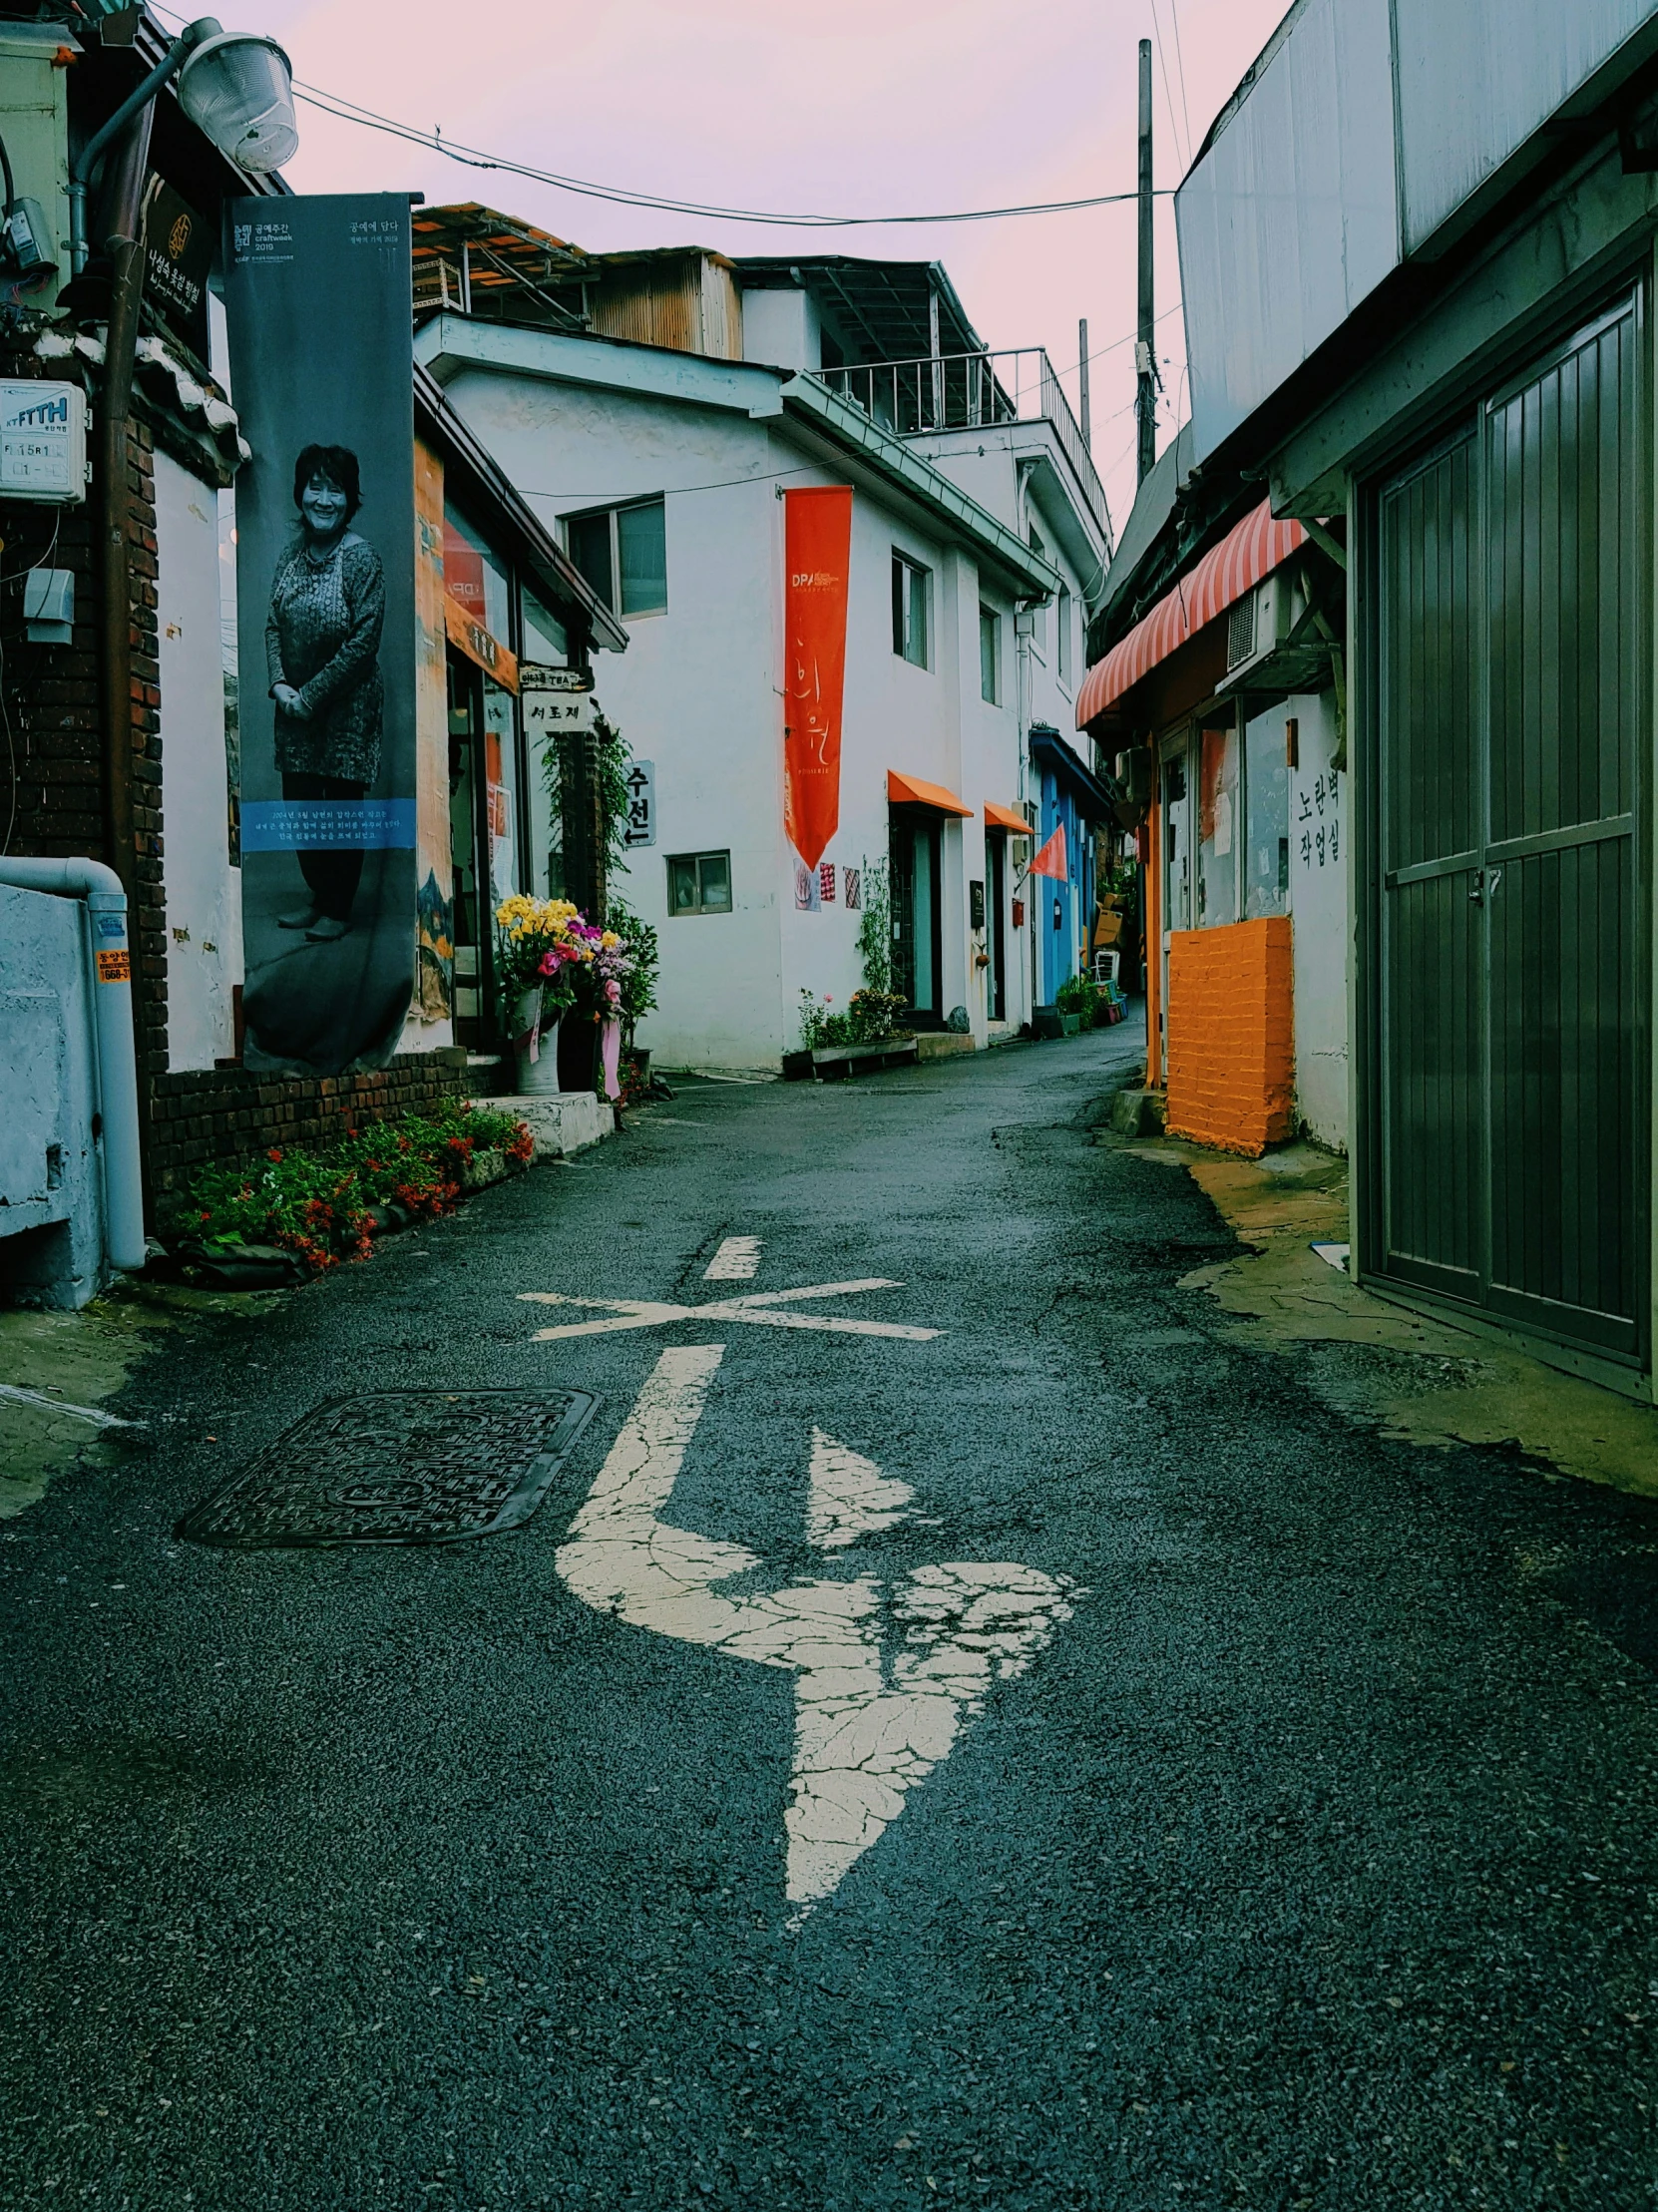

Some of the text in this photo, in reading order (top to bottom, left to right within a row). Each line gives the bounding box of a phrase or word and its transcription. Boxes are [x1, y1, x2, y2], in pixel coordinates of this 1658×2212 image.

[254, 223, 289, 234] 공예주간
[349, 220, 399, 233] 공예에 담다
[149, 248, 171, 279] 나성숙
[170, 268, 187, 291] 옻칠
[18, 396, 68, 427] FTTH
[549, 675, 570, 685] TEA
[531, 706, 580, 719] 서로재
[626, 767, 649, 829] 수선
[1298, 770, 1339, 821] 노란벽
[1300, 818, 1339, 870] 작업실
